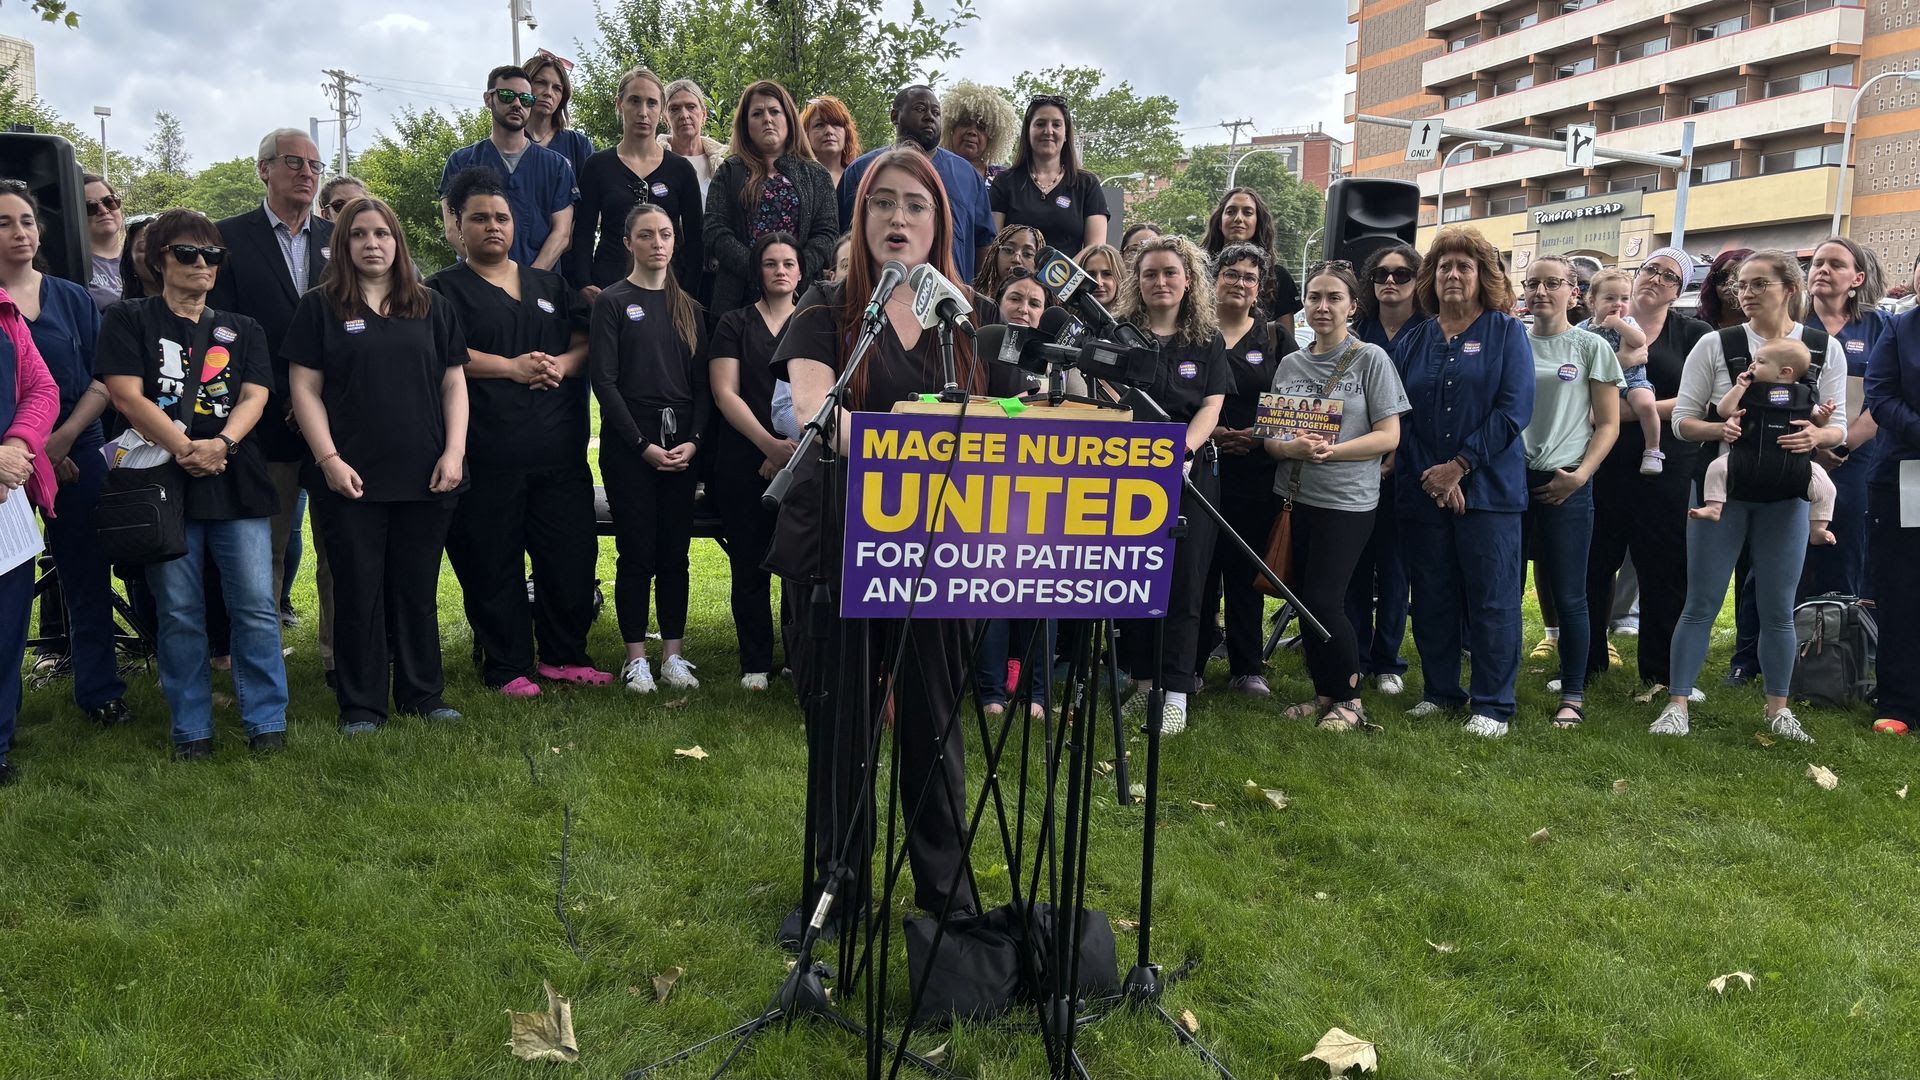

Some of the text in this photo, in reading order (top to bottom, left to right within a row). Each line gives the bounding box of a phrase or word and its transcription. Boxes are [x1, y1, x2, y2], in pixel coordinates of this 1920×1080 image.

[1410, 149, 1431, 158] ONLY
[1534, 203, 1621, 224] Panera BREAD
[916, 277, 933, 314] KDKA
[1060, 271, 1083, 300] NEWS
[159, 338, 185, 379] I
[157, 395, 231, 418] NCU
[1269, 409, 1329, 422] WE'RE MOVING
[1257, 416, 1340, 432] FORWARD TOGETHER
[862, 429, 1175, 468] MAGEE NURSES
[861, 471, 1169, 536] UNITED
[856, 541, 1164, 571] FOR OUR PATIENTS
[862, 577, 1151, 604] AND PROFESSION
